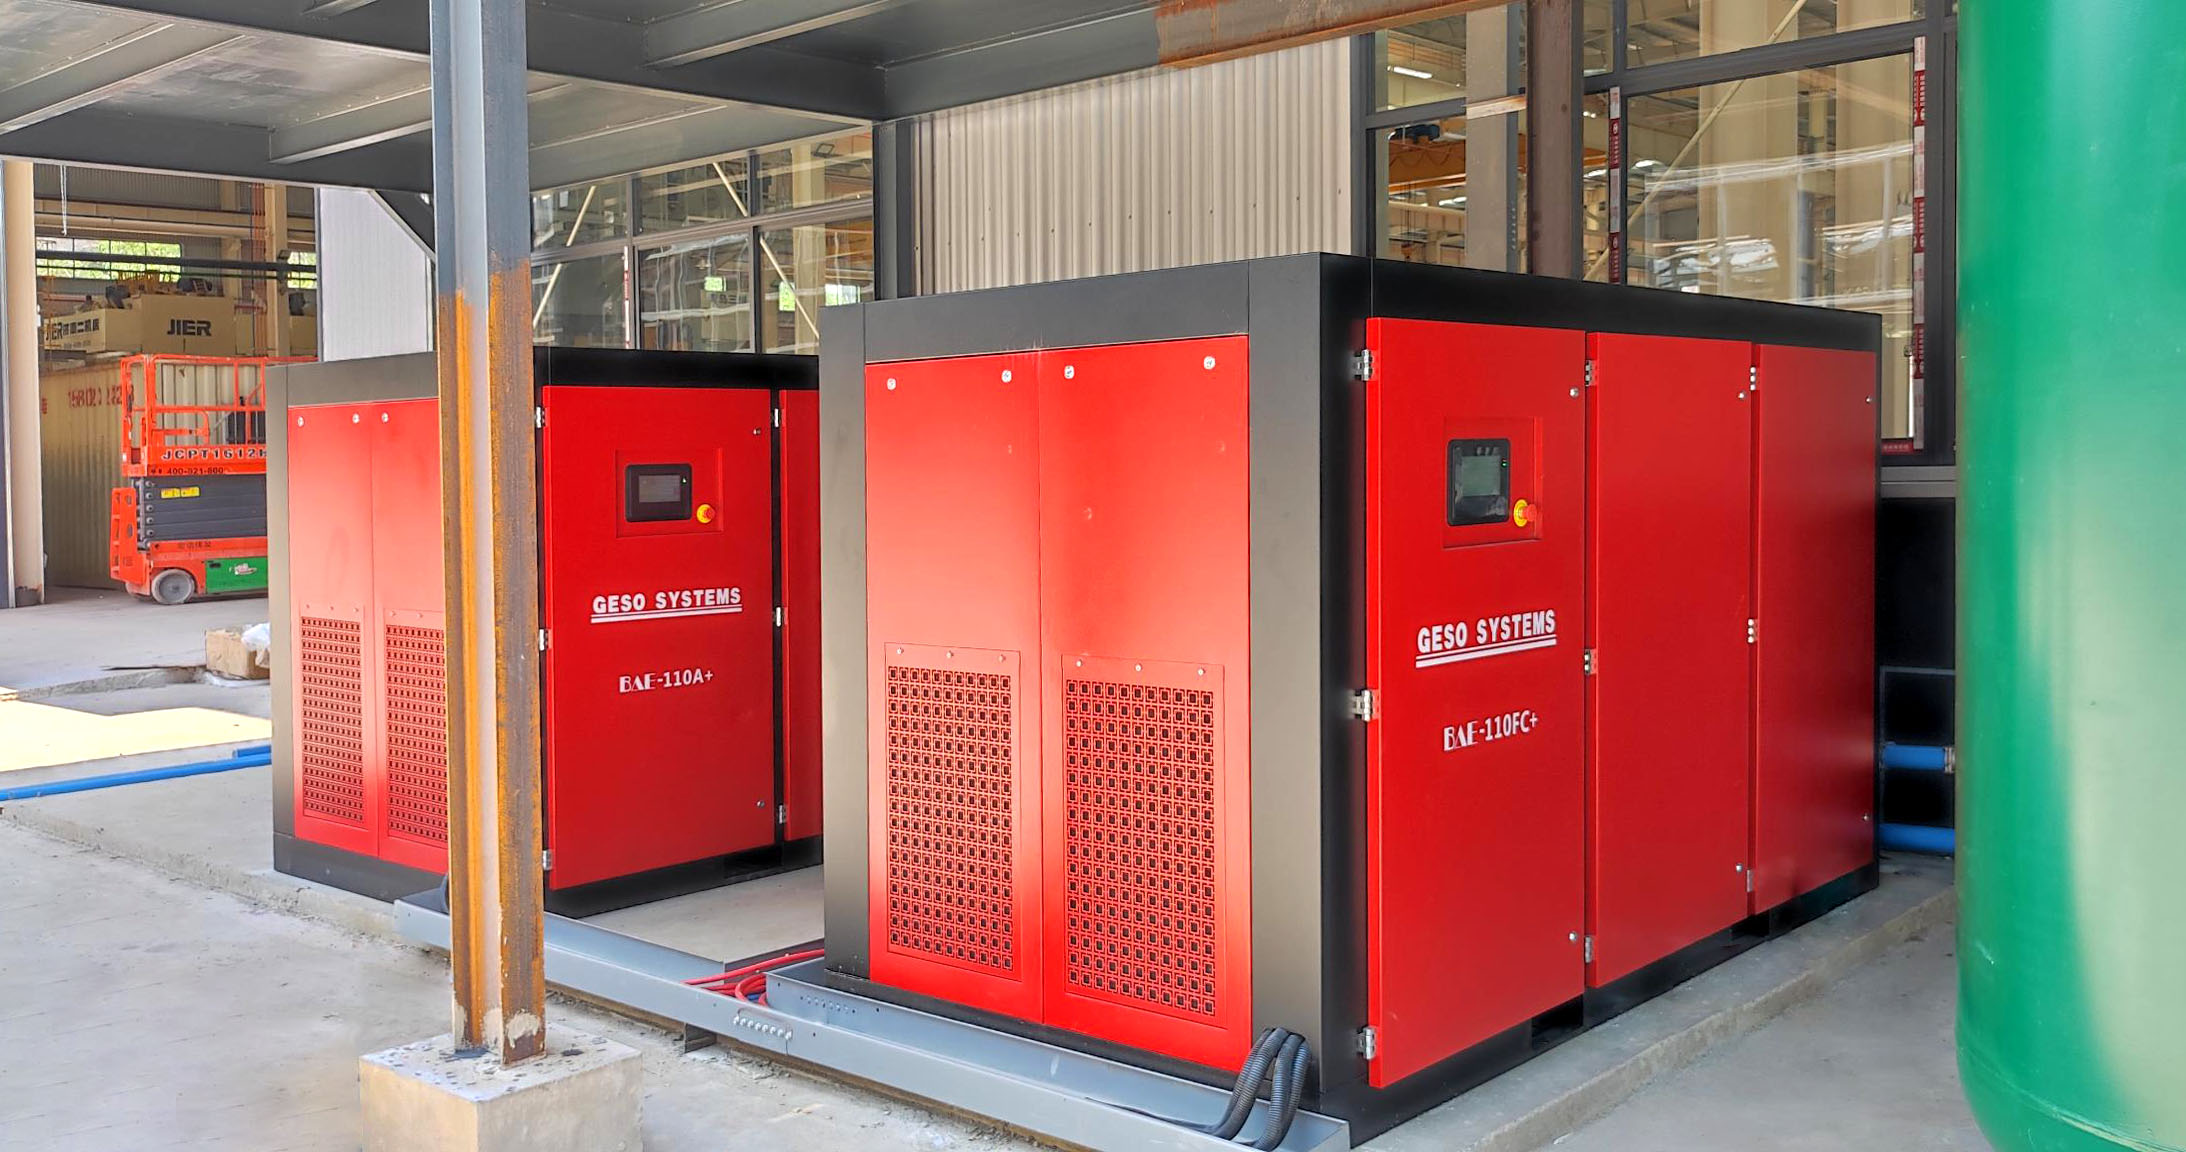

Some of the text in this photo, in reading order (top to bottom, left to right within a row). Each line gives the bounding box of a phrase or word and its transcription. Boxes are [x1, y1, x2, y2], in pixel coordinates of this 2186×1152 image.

[167, 318, 212, 337] JIER
[593, 587, 742, 614] GESO SYSTEMS
[1417, 609, 1556, 653] GESO SYSTEMS
[619, 667, 714, 693] BAE-110A+
[1443, 709, 1539, 752] BAE-110FC+
